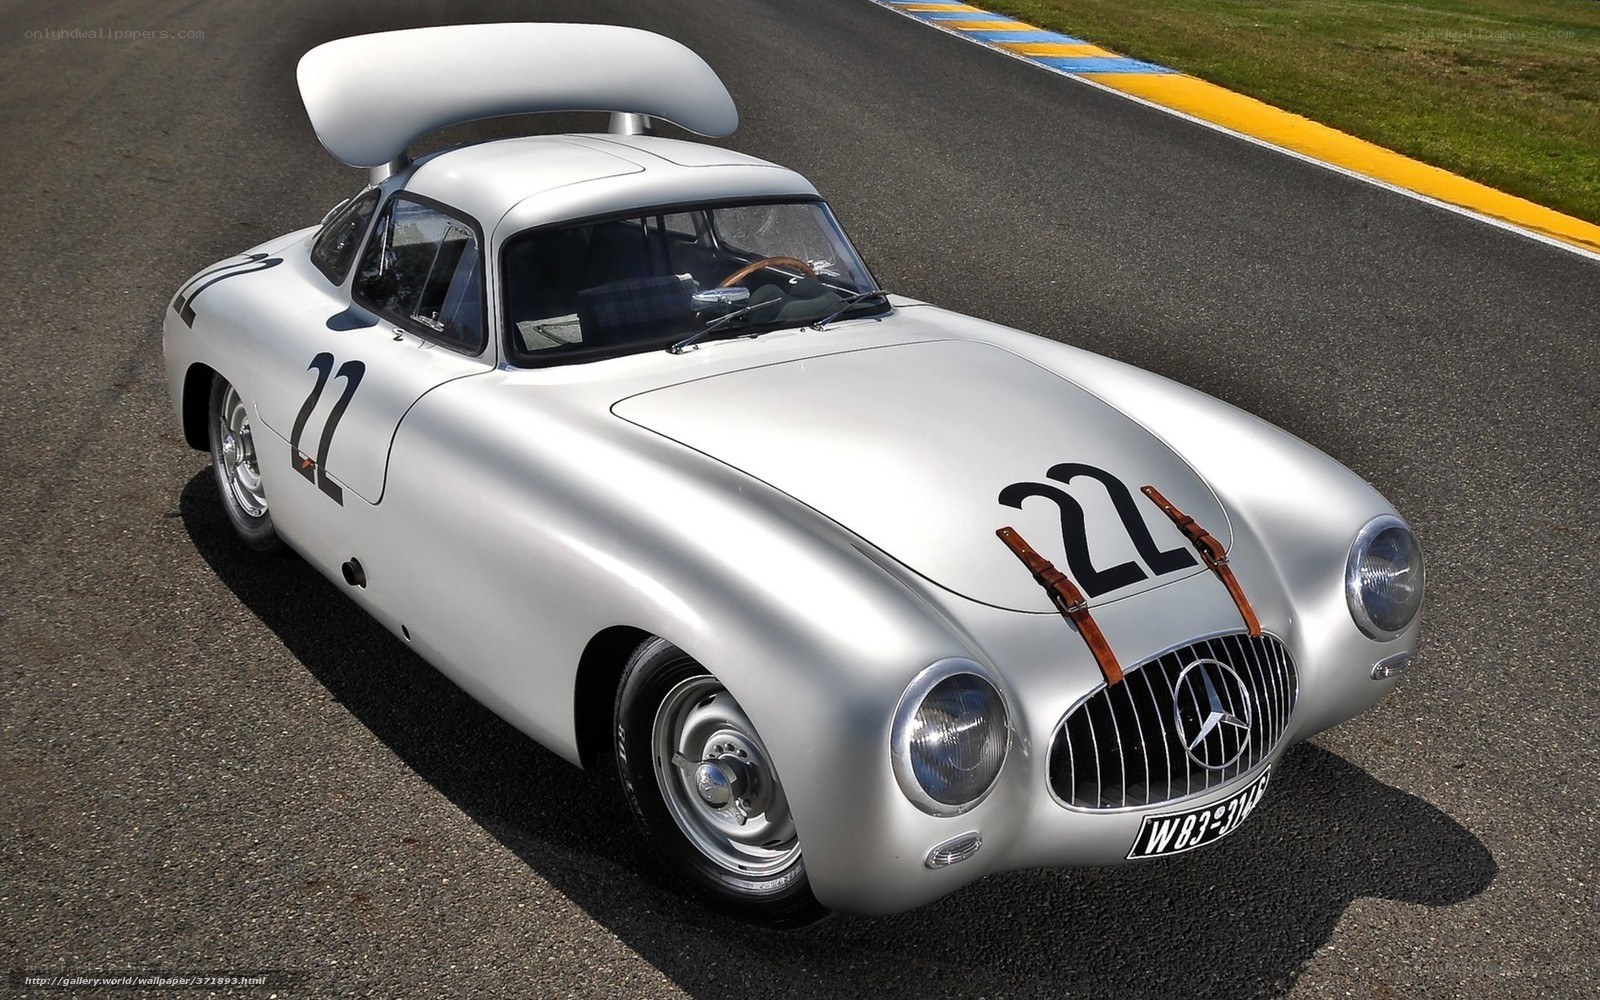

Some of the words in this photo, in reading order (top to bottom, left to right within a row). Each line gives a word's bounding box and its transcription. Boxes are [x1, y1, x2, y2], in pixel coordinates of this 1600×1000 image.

[172, 252, 284, 330] 22
[290, 352, 366, 507] 22
[998, 462, 1199, 598] 22
